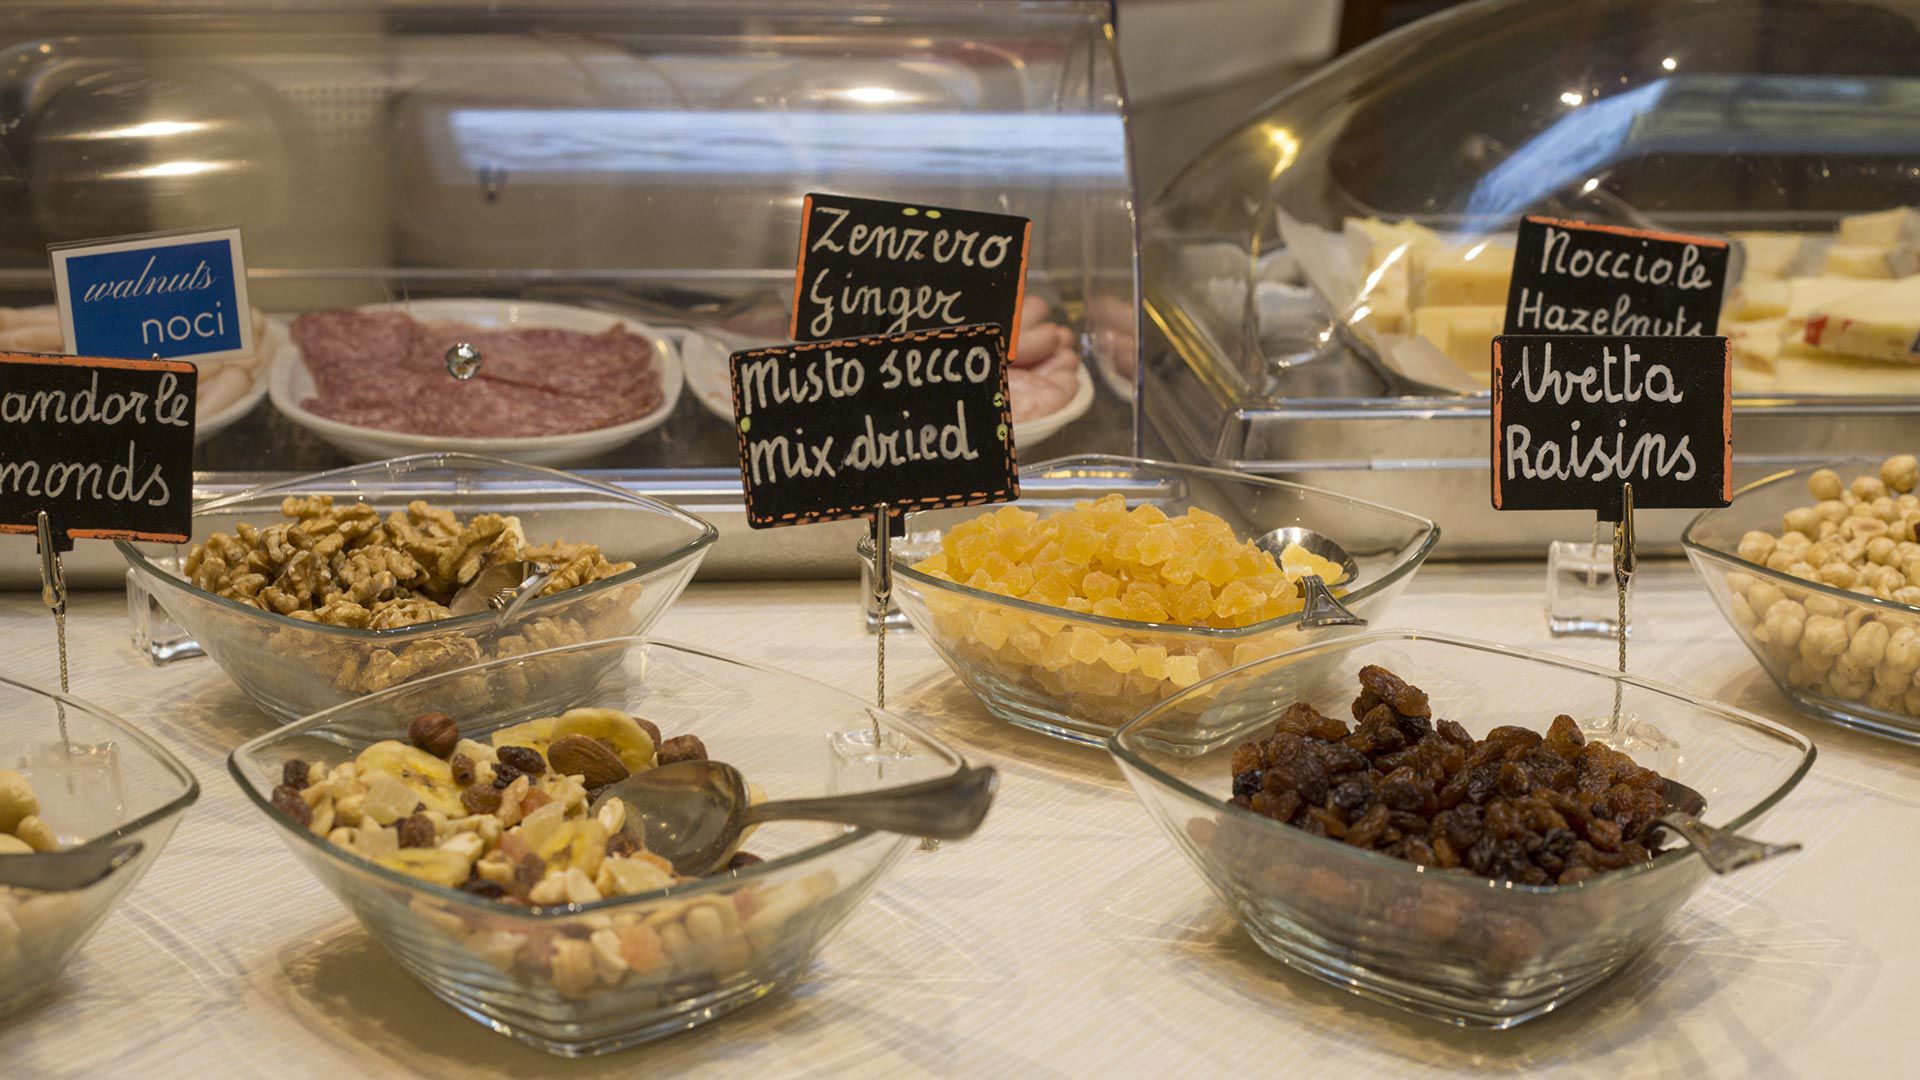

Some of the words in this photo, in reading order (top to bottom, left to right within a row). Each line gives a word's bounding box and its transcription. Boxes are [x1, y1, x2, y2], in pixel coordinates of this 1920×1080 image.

[811, 206, 1013, 268] Zenzero
[1541, 227, 1713, 289] Nocciole
[84, 255, 217, 303] walnuts
[810, 269, 966, 336] Ginger
[142, 302, 225, 345] noci
[880, 345, 991, 390] secco
[1511, 342, 1684, 406] Uvetta
[0, 371, 190, 427] andorle
[844, 400, 979, 471] dried
[1506, 419, 1697, 482] Raisins
[0, 440, 171, 506] monds
